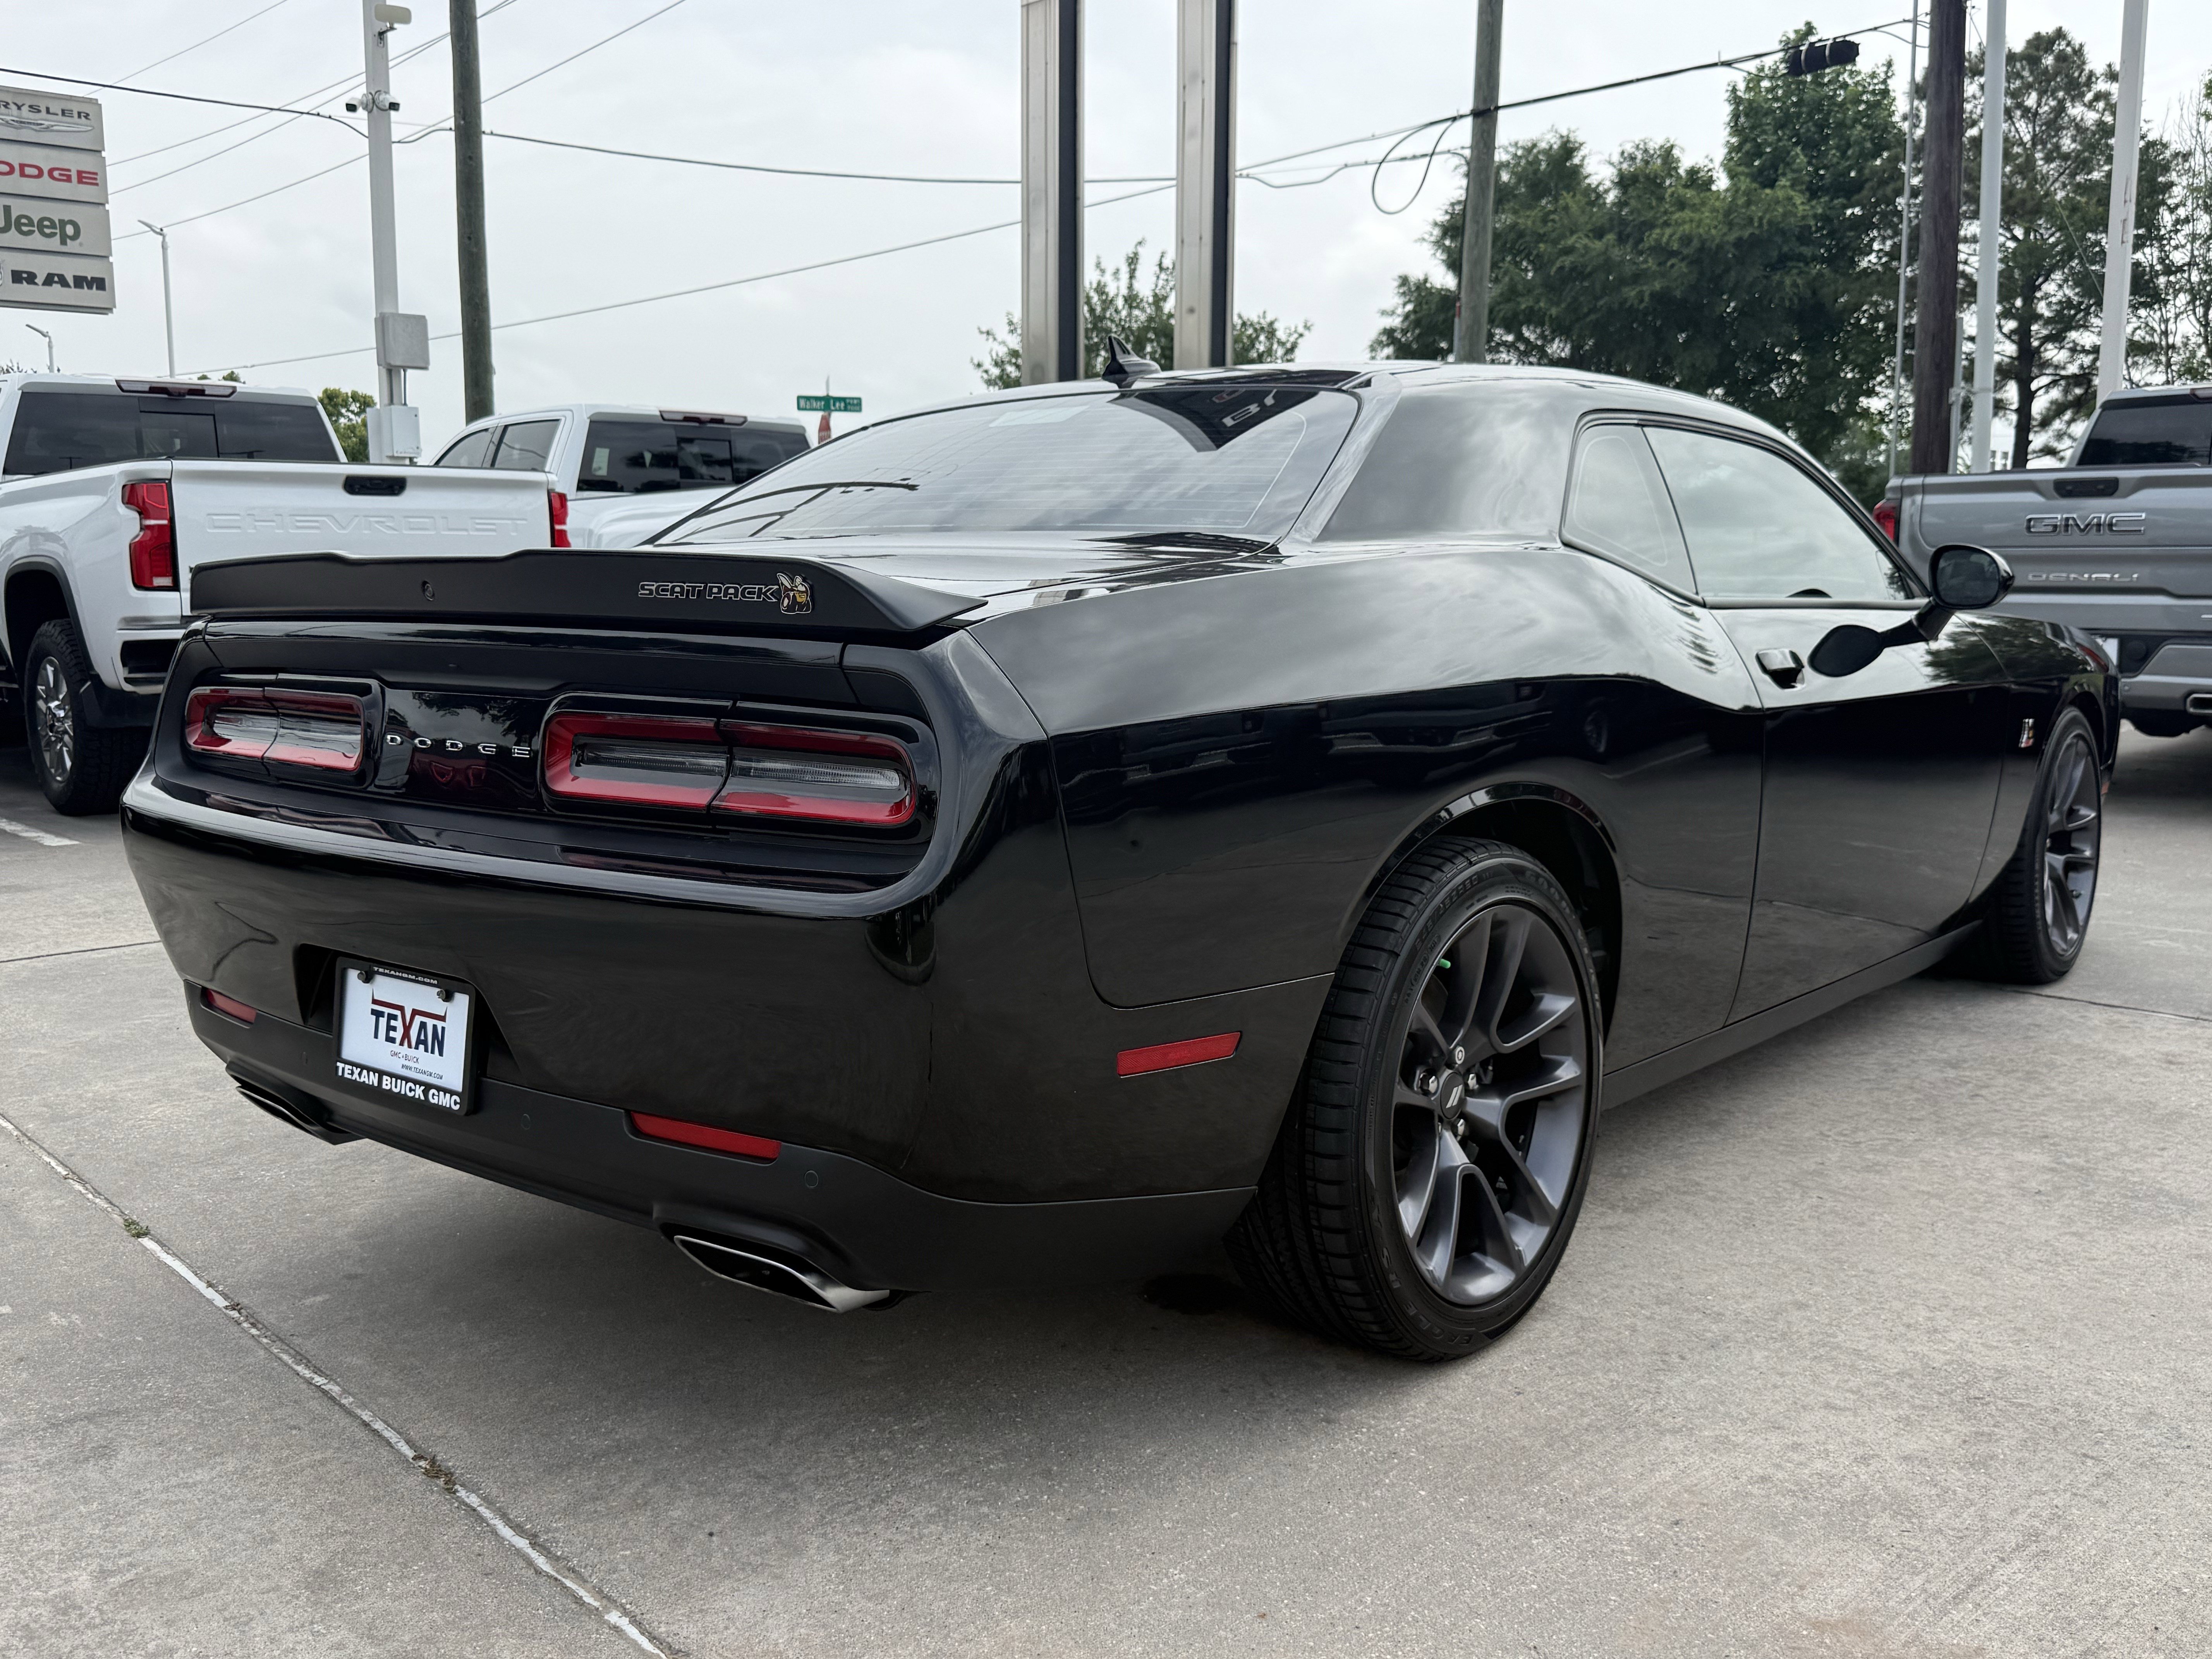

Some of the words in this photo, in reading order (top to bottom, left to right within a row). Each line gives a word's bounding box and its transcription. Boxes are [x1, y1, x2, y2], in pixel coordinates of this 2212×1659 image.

[0, 204, 81, 246] Jeep
[10, 270, 106, 292] RAM
[799, 398, 824, 409] Walker
[830, 399, 845, 410] Lee
[205, 513, 528, 536] CHEVROLET
[2025, 512, 2146, 536] GMC
[2028, 572, 2140, 582] DENALI
[638, 582, 704, 599] SCAT
[706, 583, 779, 602] PACK
[386, 735, 531, 758] DODGE
[373, 967, 438, 984] TEXANGM.COM
[370, 998, 447, 1057] TEXAN
[390, 1050, 402, 1059] GMC
[404, 1053, 419, 1064] BUICK
[336, 1062, 378, 1087] TEXAN
[382, 1075, 425, 1100] BUICK
[428, 1089, 460, 1110] GMC
